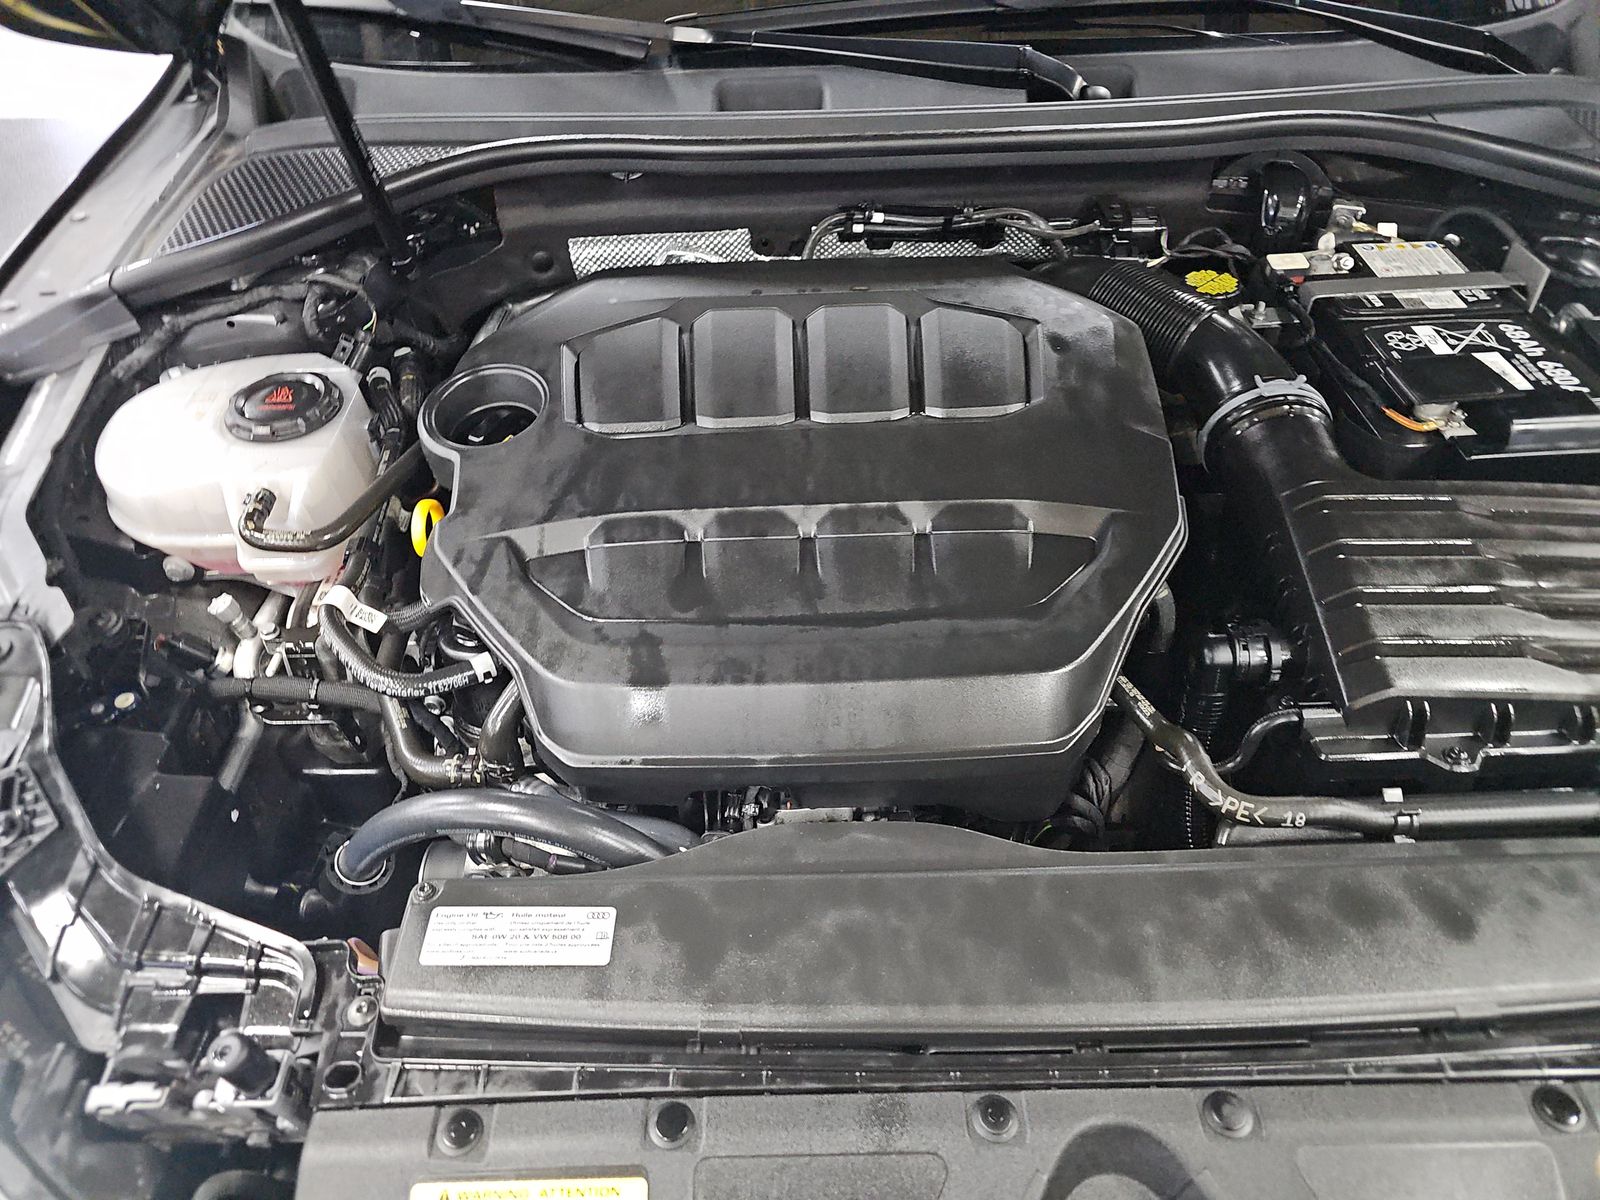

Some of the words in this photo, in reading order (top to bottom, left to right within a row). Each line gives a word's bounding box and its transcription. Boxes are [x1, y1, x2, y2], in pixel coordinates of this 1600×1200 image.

[1498, 323, 1547, 357] 68Ah
[1281, 811, 1306, 827] 18
[435, 912, 464, 920] Engine
[540, 1185, 620, 1198] ATTENTION
